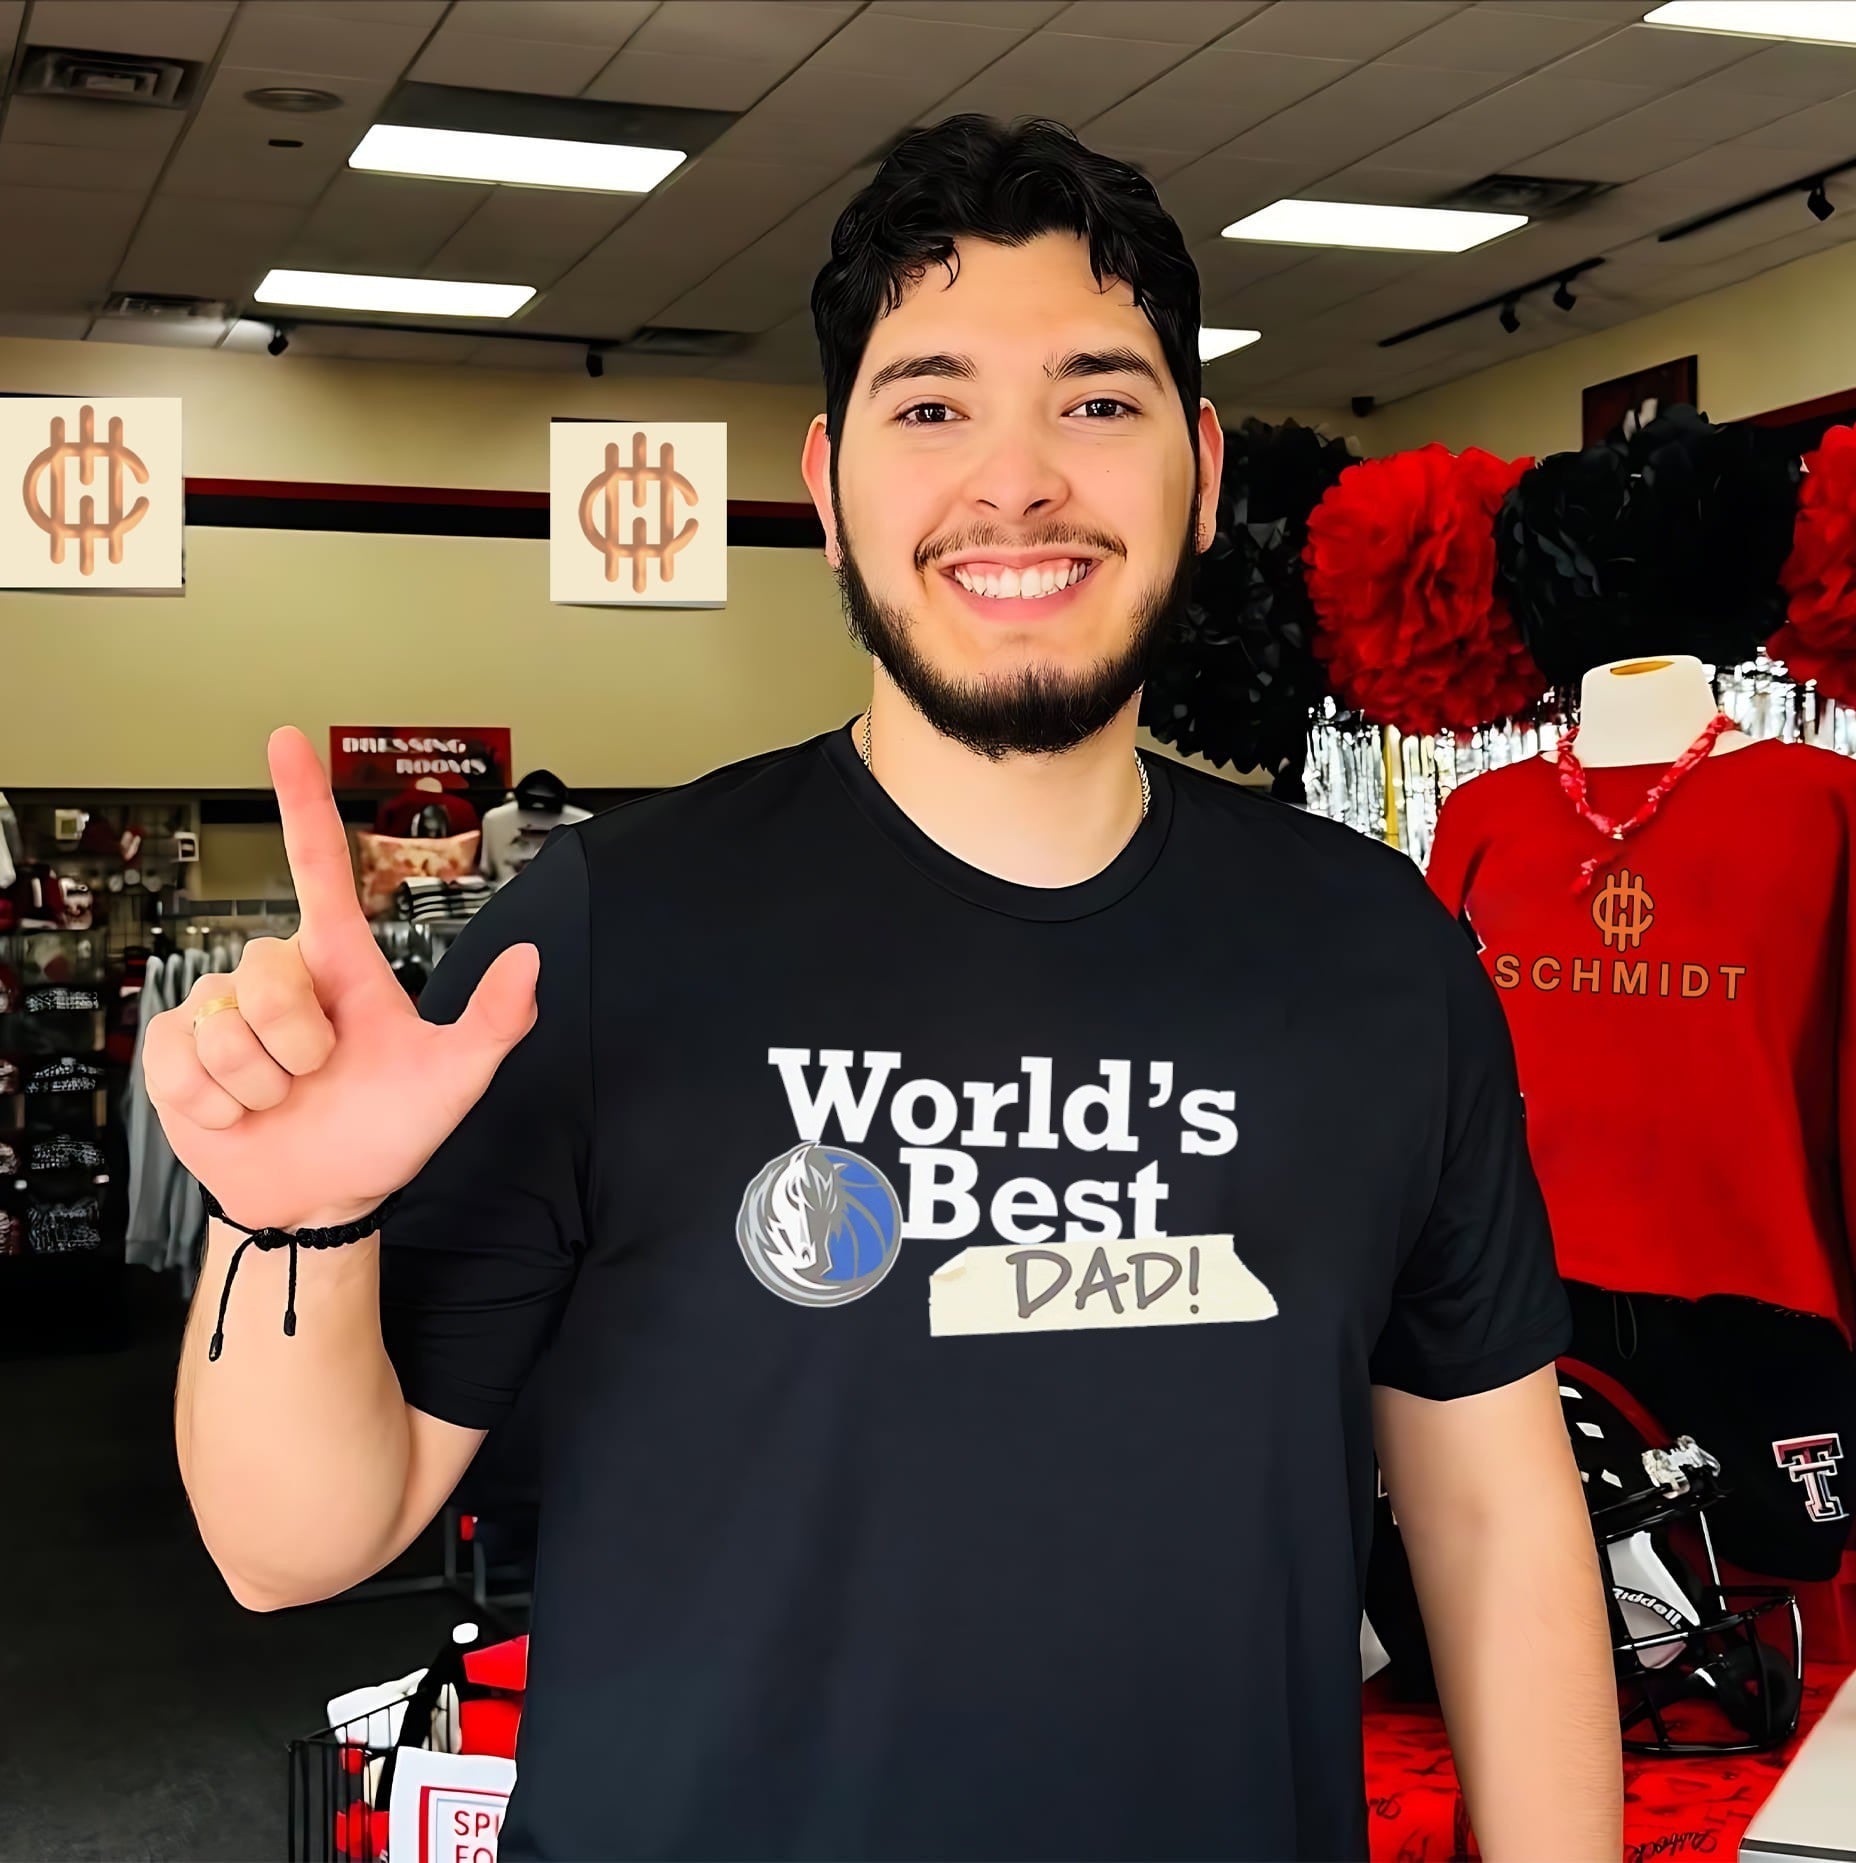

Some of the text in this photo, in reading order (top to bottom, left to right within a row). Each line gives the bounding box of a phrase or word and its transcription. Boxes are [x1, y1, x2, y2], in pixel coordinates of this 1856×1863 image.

[342, 737, 466, 754] DRESSING
[396, 758, 487, 775] ROOMS
[1494, 954, 1747, 1000] SCHMIDT
[767, 1047, 1238, 1156] World's
[899, 1147, 1169, 1244] Best
[1005, 1246, 1199, 1319] DAD!
